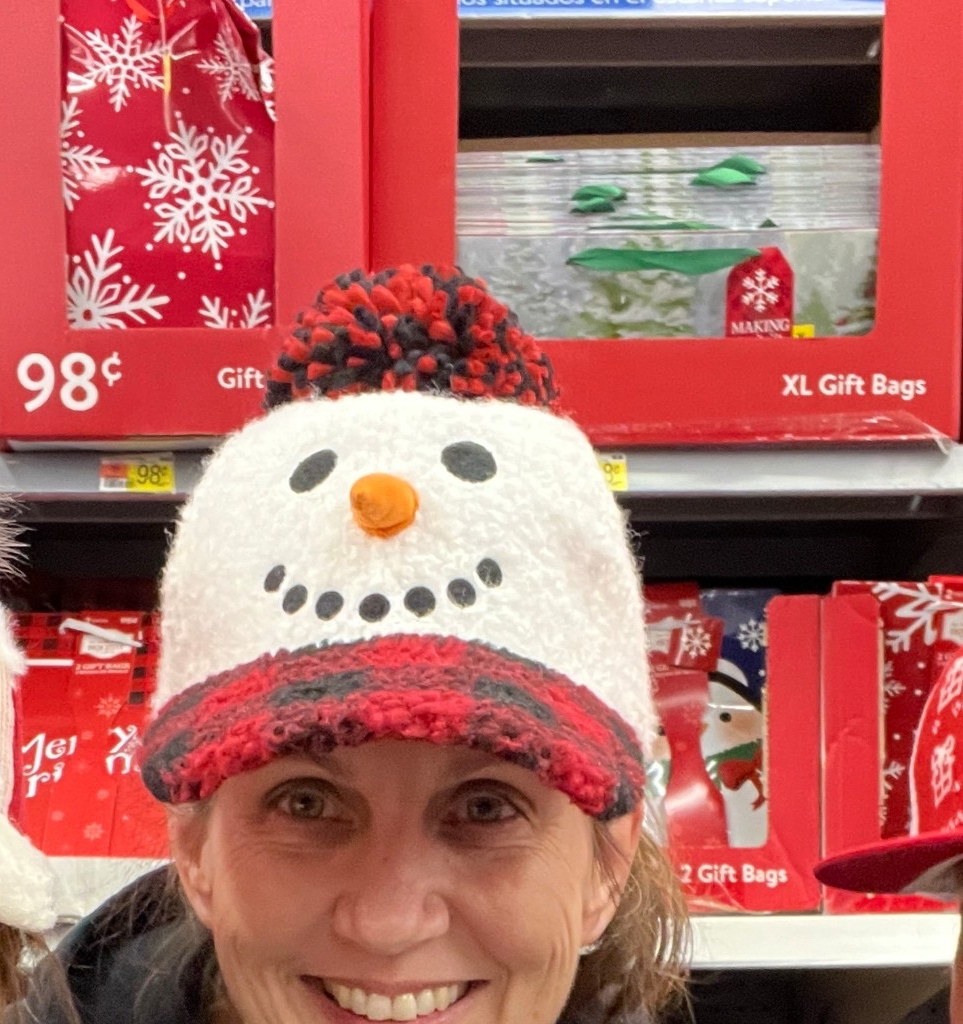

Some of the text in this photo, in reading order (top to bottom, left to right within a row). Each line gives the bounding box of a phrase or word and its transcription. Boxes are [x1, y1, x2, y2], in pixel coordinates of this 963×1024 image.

[731, 318, 790, 335] MAKING
[17, 351, 122, 413] 98¢
[217, 366, 265, 390] Gift
[782, 373, 927, 401] XL Gift Bags
[680, 863, 788, 889] 2 Gift Bags
